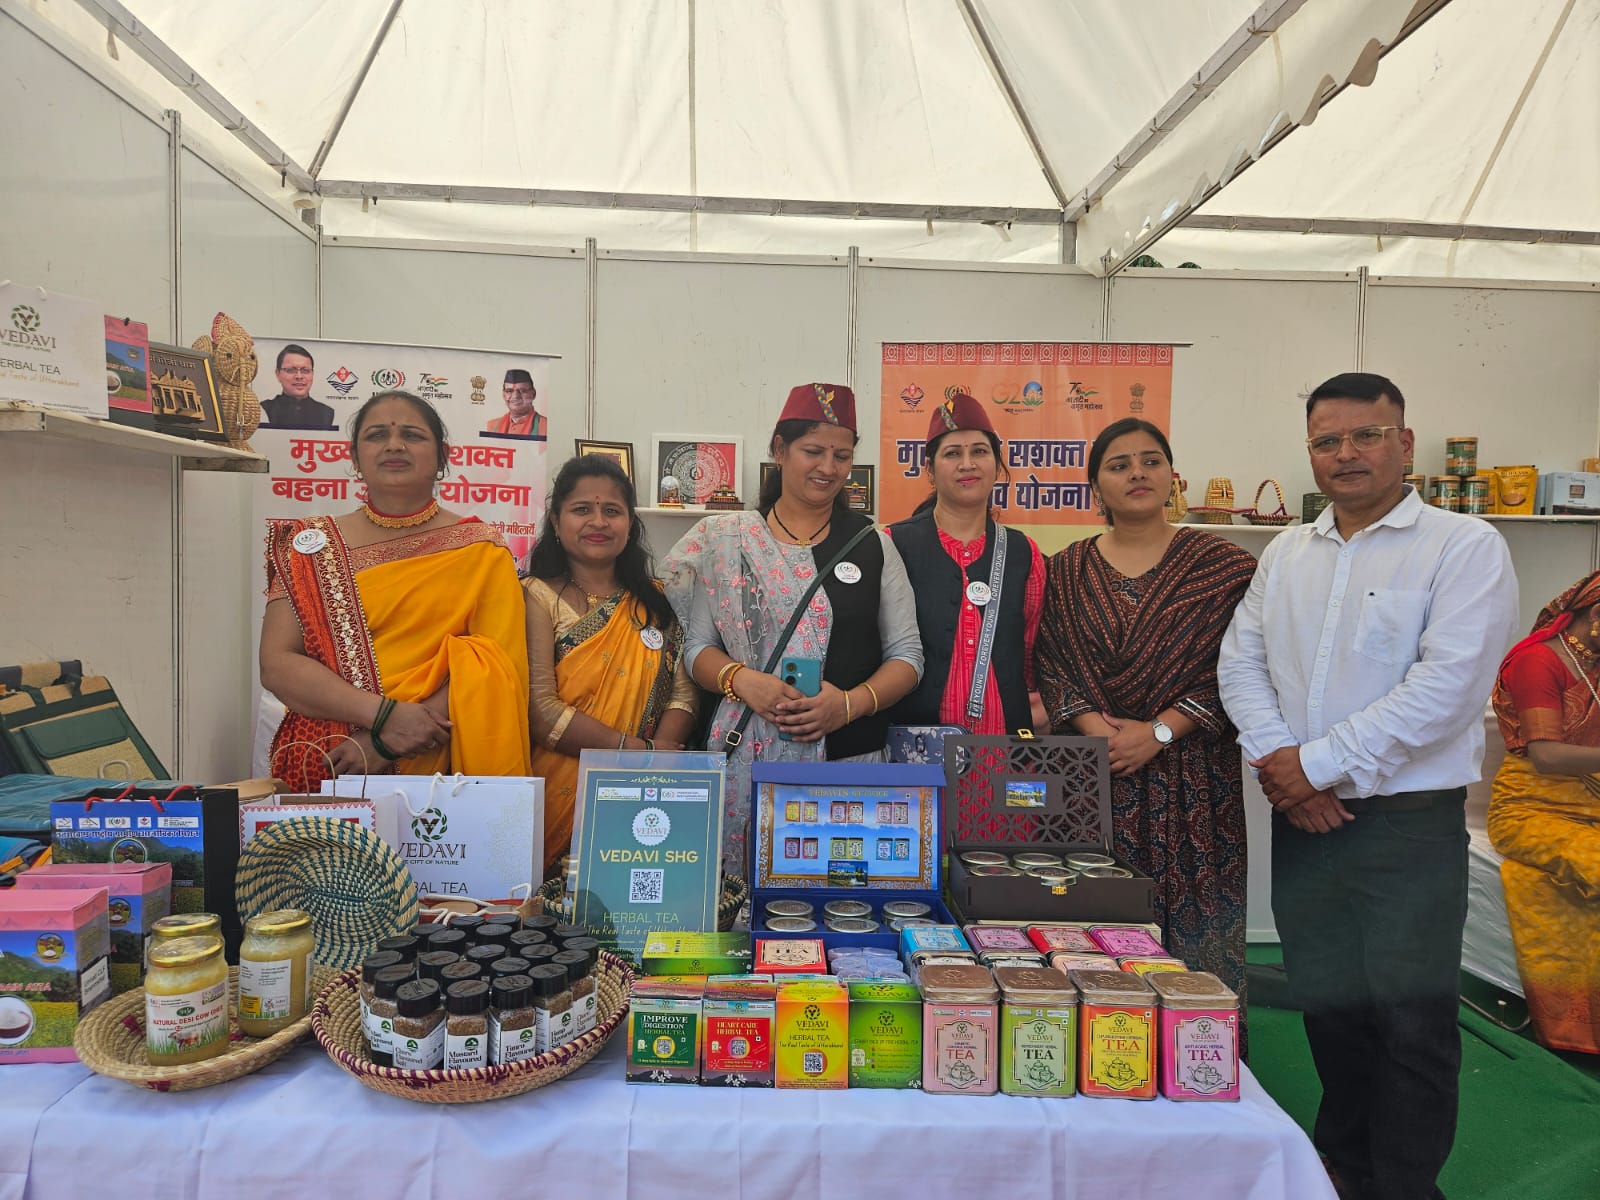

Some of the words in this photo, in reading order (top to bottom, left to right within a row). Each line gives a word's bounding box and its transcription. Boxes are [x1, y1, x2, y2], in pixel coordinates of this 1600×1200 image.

[0, 358, 37, 372] ERBAL
[40, 363, 61, 375] TEA
[448, 444, 516, 469] शक्त
[1007, 439, 1087, 468] सशक्त
[271, 477, 350, 501] बहना
[438, 474, 532, 507] योजना
[1014, 473, 1091, 512] योजना
[995, 549, 1005, 573] YOUNG
[991, 573, 1002, 602] FOREVER
[979, 631, 991, 666] FOREVER
[985, 608, 996, 632] YOUNG
[972, 673, 984, 701] YOUNG
[636, 827, 667, 835] VEDAVI
[600, 850, 659, 864] VEDAVI
[664, 851, 698, 864] SHG
[413, 881, 438, 894] BAL
[441, 882, 468, 894] TEA
[603, 911, 652, 924] HERBAL
[656, 911, 679, 923] TEA
[587, 925, 600, 935] The
[603, 925, 618, 935] Real
[621, 925, 641, 935] Taste
[152, 1017, 177, 1026] NATURAL
[179, 1015, 194, 1024] DESI
[195, 1012, 209, 1021] COW
[643, 1015, 688, 1023] IMPROVE
[796, 1020, 829, 1028] VEDAVI
[870, 1026, 904, 1034] VEDAVI
[1102, 1039, 1141, 1051] TEA
[448, 1050, 478, 1058] Mustard
[448, 1055, 482, 1064] Flavoured
[945, 1049, 975, 1061] TEA
[1023, 1049, 1055, 1060] TEA
[1187, 1049, 1222, 1061] TEA
